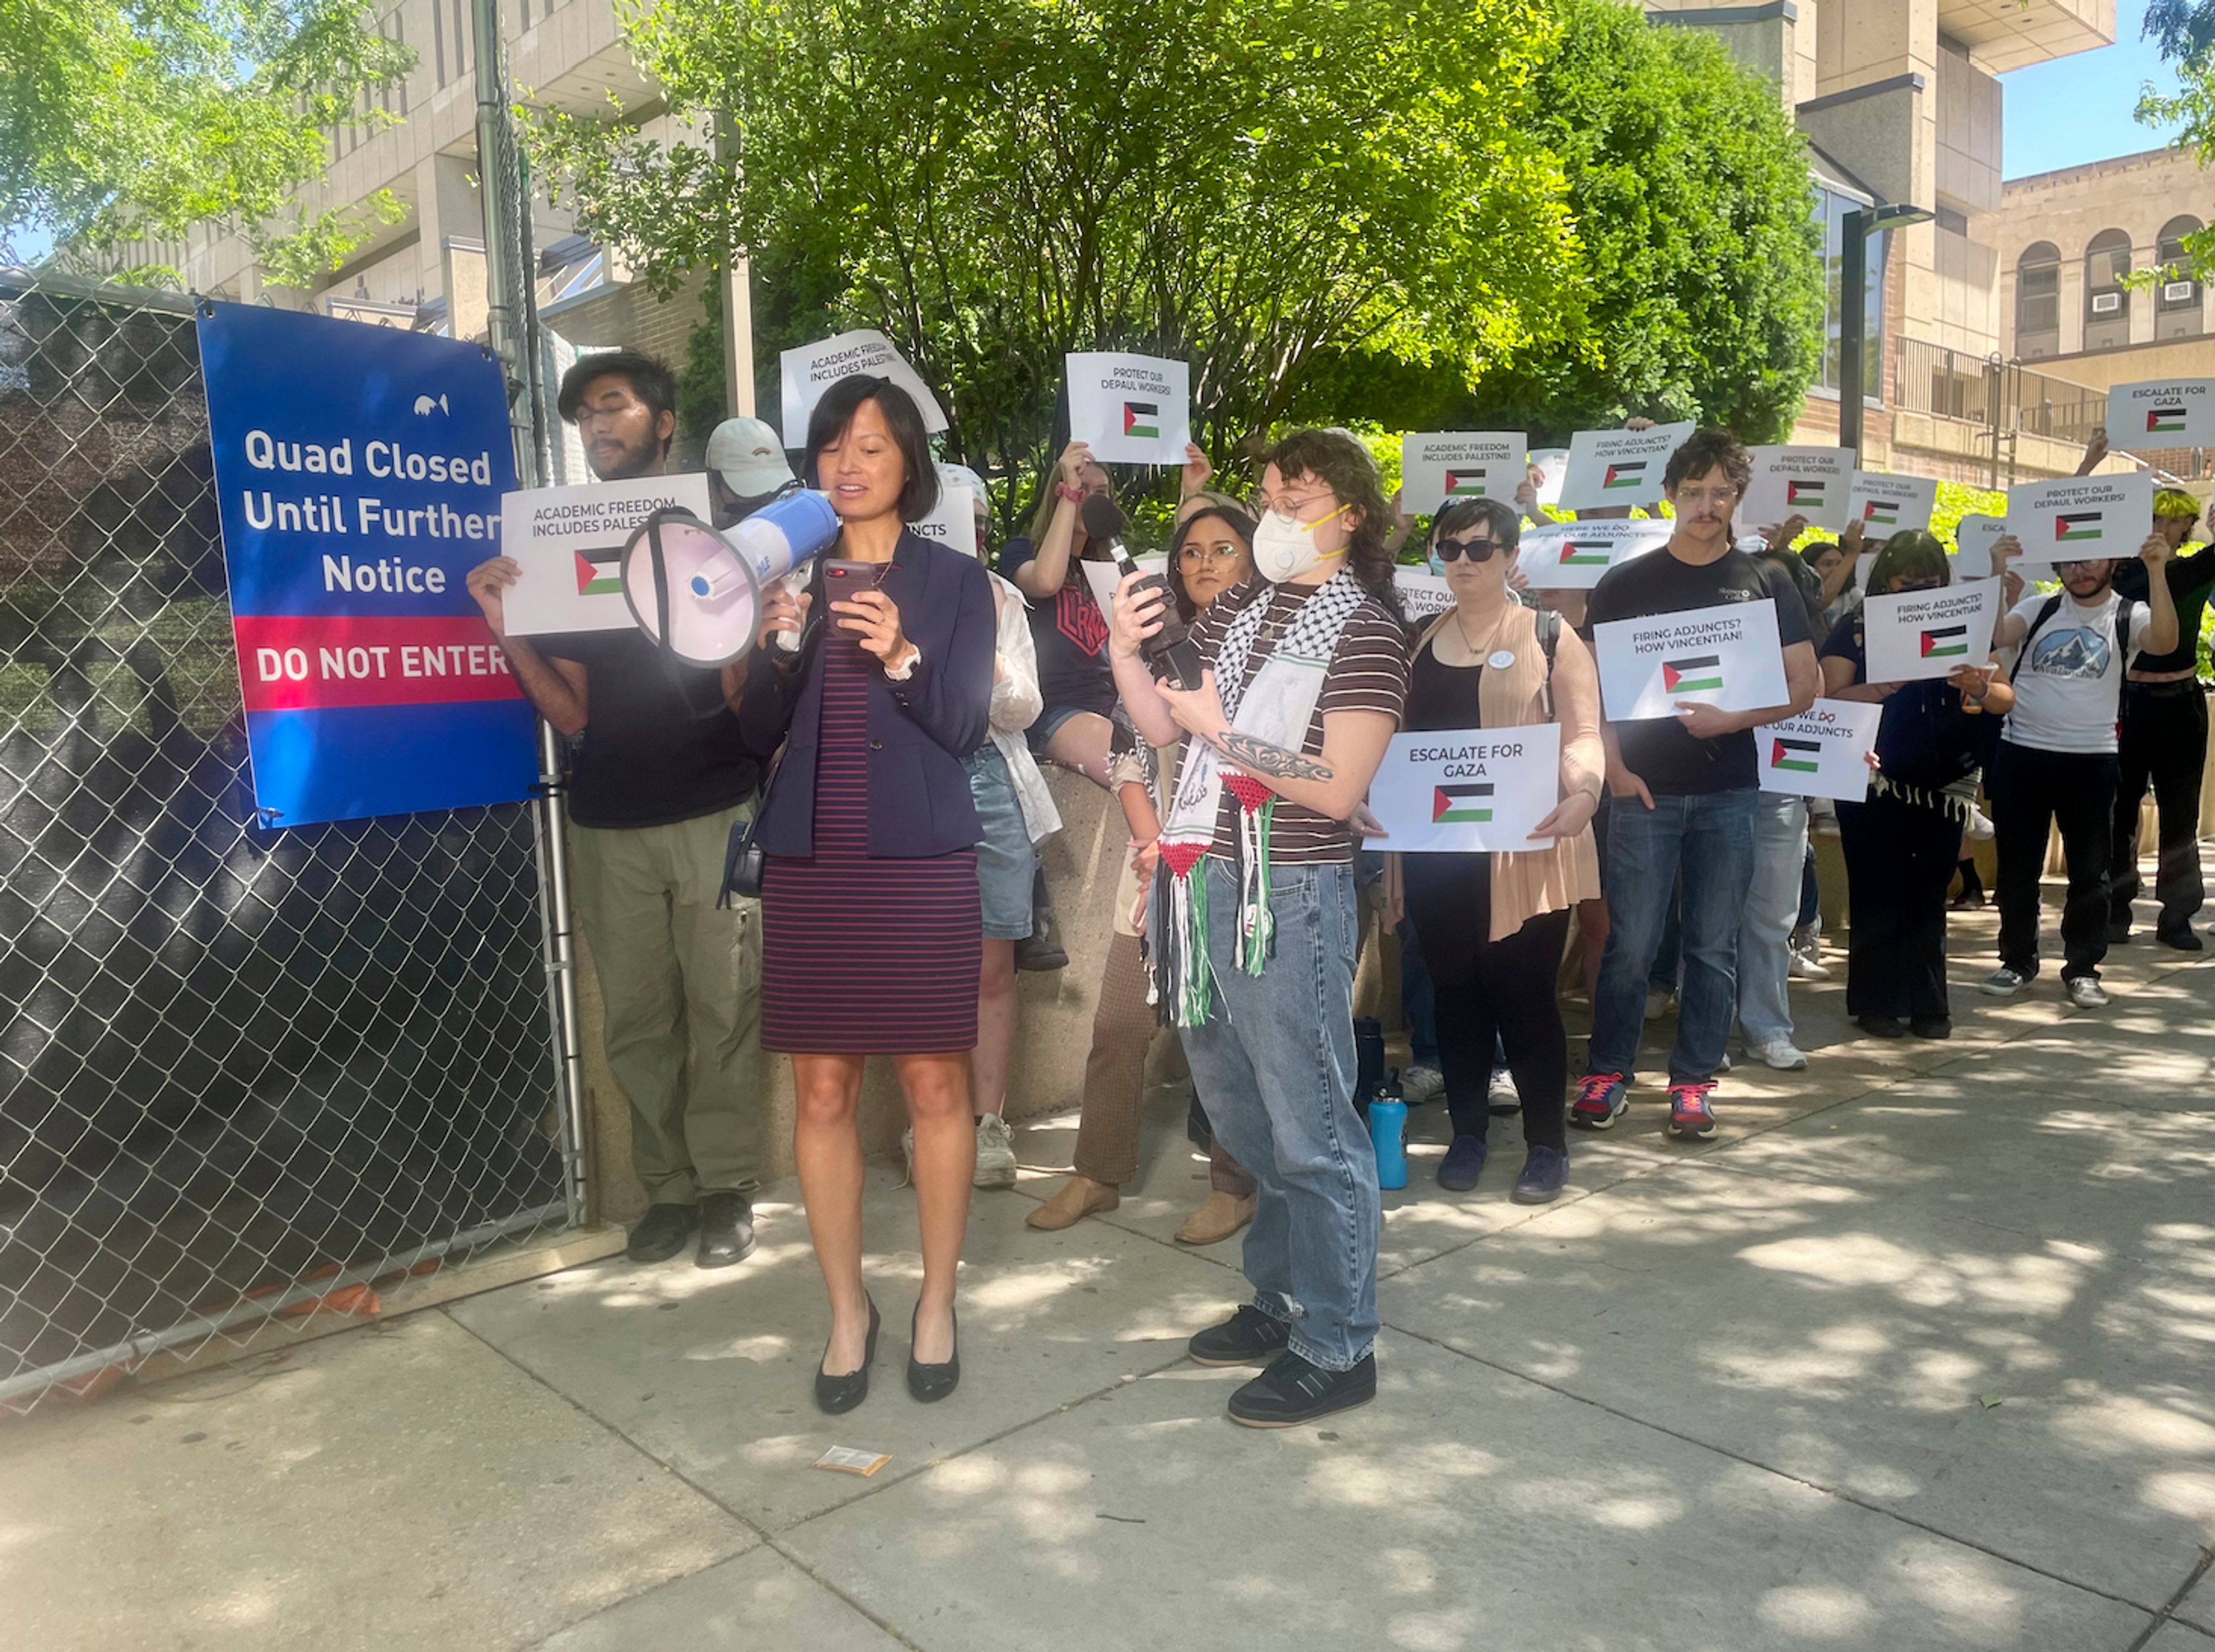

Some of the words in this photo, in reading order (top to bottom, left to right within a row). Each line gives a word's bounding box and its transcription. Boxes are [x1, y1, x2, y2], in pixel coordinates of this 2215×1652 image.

[810, 347, 861, 370] ACADEMIC
[810, 362, 860, 382] INCLUDES
[1113, 368, 1148, 379] PROTECT
[1150, 372, 1162, 381] OUR
[1101, 380, 1136, 391] DEPAUL
[2133, 387, 2182, 398] ESCALATE
[2185, 386, 2206, 395] FOR
[2154, 397, 2182, 406] GAZA
[1424, 444, 1467, 452] ACADEMIC
[1596, 440, 1623, 448] FIRING
[1625, 434, 1670, 446] ADJUNCTS?
[245, 430, 354, 475] Quad
[366, 440, 491, 486] Closed
[1422, 453, 1462, 461] INCLUDES
[1465, 452, 1511, 460] PALESTINE!
[1781, 456, 1816, 464] PROTECT
[1770, 464, 1800, 473] DEPAUL
[1852, 486, 1879, 495] DEPAUL
[1863, 479, 1894, 489] PROTECT
[2047, 487, 2089, 498] PROTECT
[2091, 485, 2113, 494] OUR
[2034, 498, 2071, 509] DEPAUL
[2074, 493, 2125, 505] WORKERS!
[243, 490, 348, 533] Until
[358, 498, 501, 539] Further
[534, 502, 605, 521] ACADEMIC
[609, 497, 676, 515] FREEDOM
[533, 520, 599, 537] INCLUDES
[323, 555, 446, 594] Notice
[1897, 603, 1931, 614] FIRING
[1933, 593, 1983, 610] ADJUNCTS?
[1898, 614, 1924, 623] HOW
[1633, 629, 1671, 642] FIRING
[1674, 618, 1741, 636] ADJUNCTS?
[1635, 642, 1665, 654] HOW
[1668, 631, 1743, 649] VINCENTIAN!
[257, 648, 308, 681] DO
[320, 647, 389, 679] NOT
[401, 645, 509, 677] ENTER
[1818, 712, 1836, 723] DO
[1772, 722, 1795, 732] OUR
[1797, 724, 1853, 738] ADJUNCTS
[1410, 746, 1486, 761] ESCALATE
[1492, 744, 1523, 758] FOR
[1444, 764, 1486, 777] GAZA
